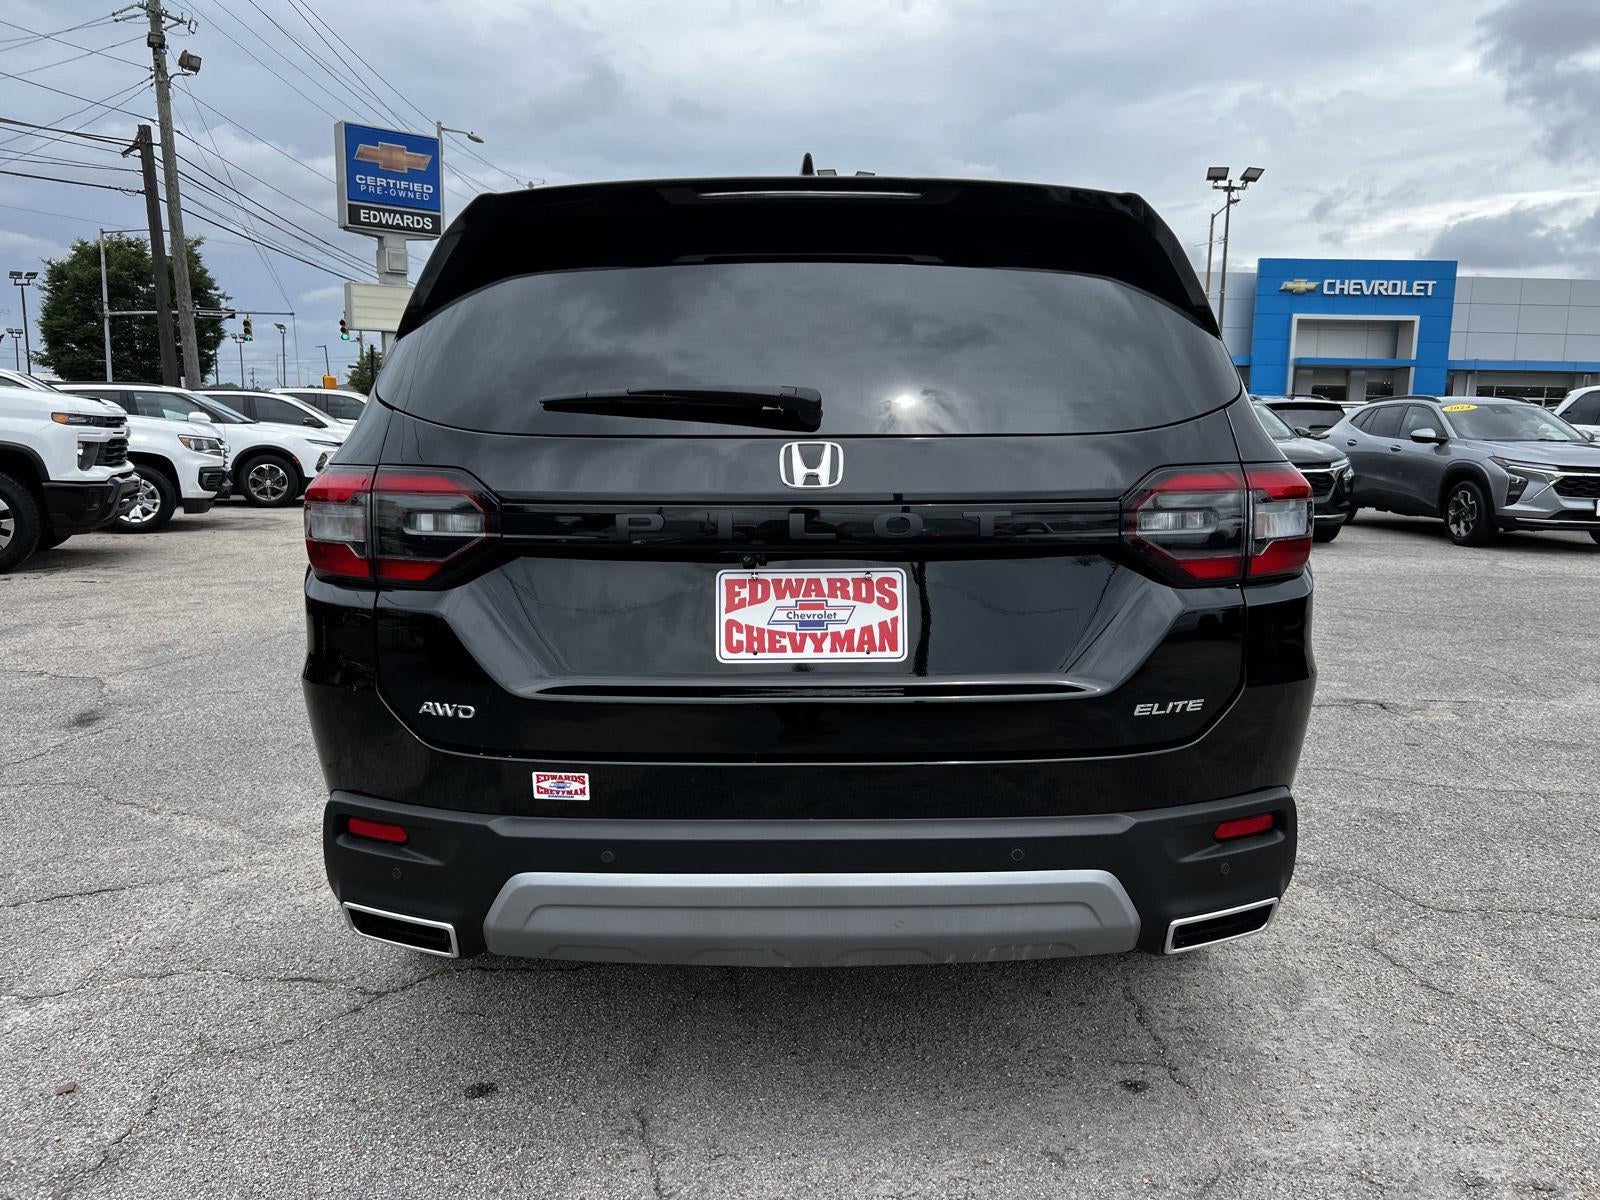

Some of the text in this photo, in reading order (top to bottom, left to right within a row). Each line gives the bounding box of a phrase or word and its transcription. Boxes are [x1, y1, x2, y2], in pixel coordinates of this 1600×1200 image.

[355, 174, 434, 194] CERTIFIED
[360, 184, 430, 201] PRE-OWNED
[360, 209, 433, 230] EDWARDS
[1322, 278, 1437, 297] CHEVROLET
[615, 510, 1012, 541] PILOT
[724, 576, 899, 614] EDWARDS
[786, 610, 837, 620] Chevrolet
[724, 615, 899, 655] CHEVYMAN
[418, 701, 476, 719] AWD
[1133, 698, 1205, 717] ELITE
[535, 773, 586, 785] EDWARDS
[536, 784, 587, 796] CHEVYMAN
